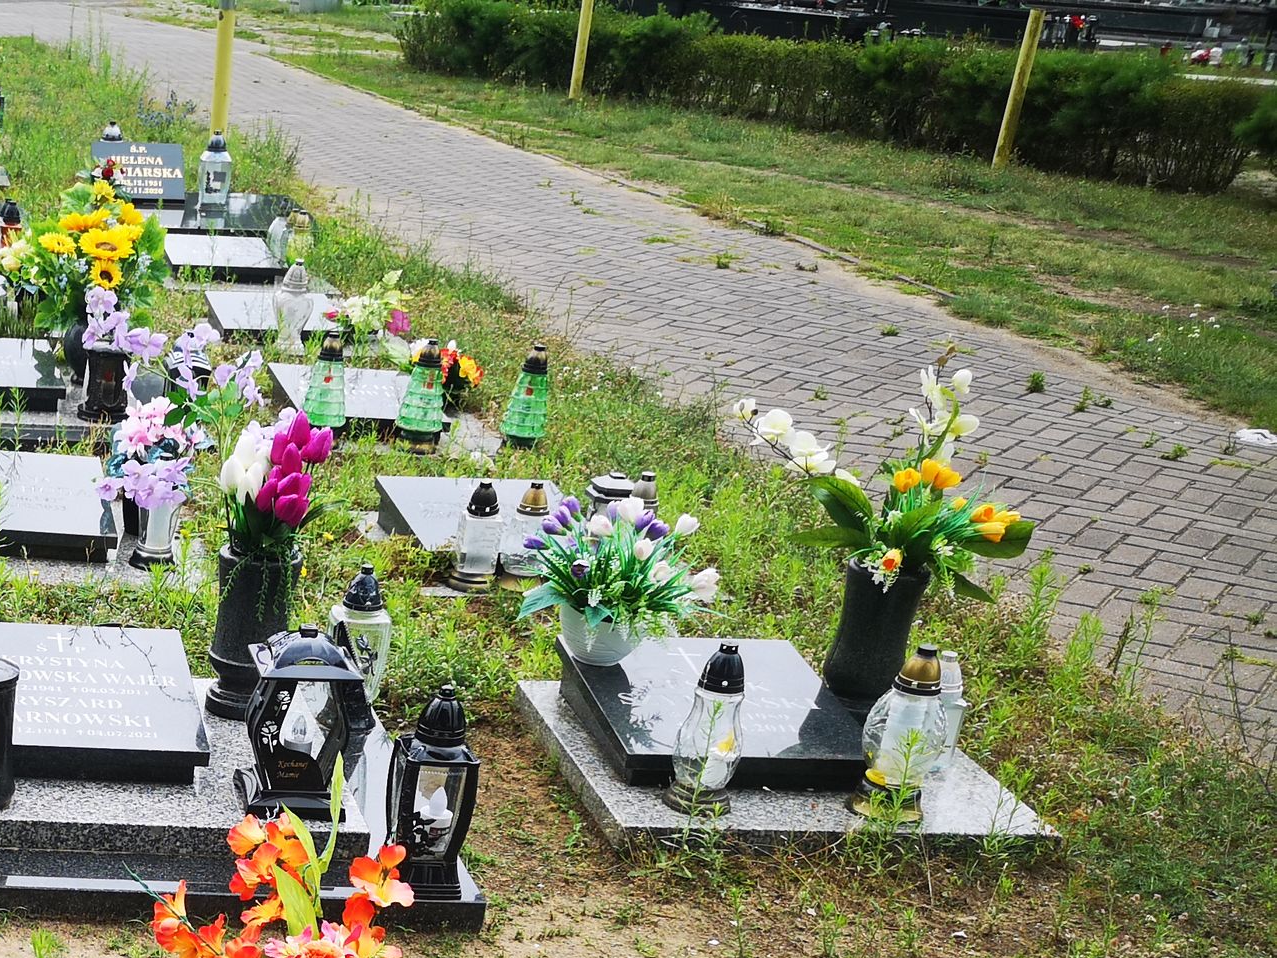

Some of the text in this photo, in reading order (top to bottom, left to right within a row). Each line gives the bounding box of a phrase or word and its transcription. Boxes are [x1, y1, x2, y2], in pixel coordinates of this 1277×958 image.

[111, 155, 163, 166] HELENA
[2, 655, 126, 669] KRYSTYNA
[103, 672, 179, 688] WAJER
